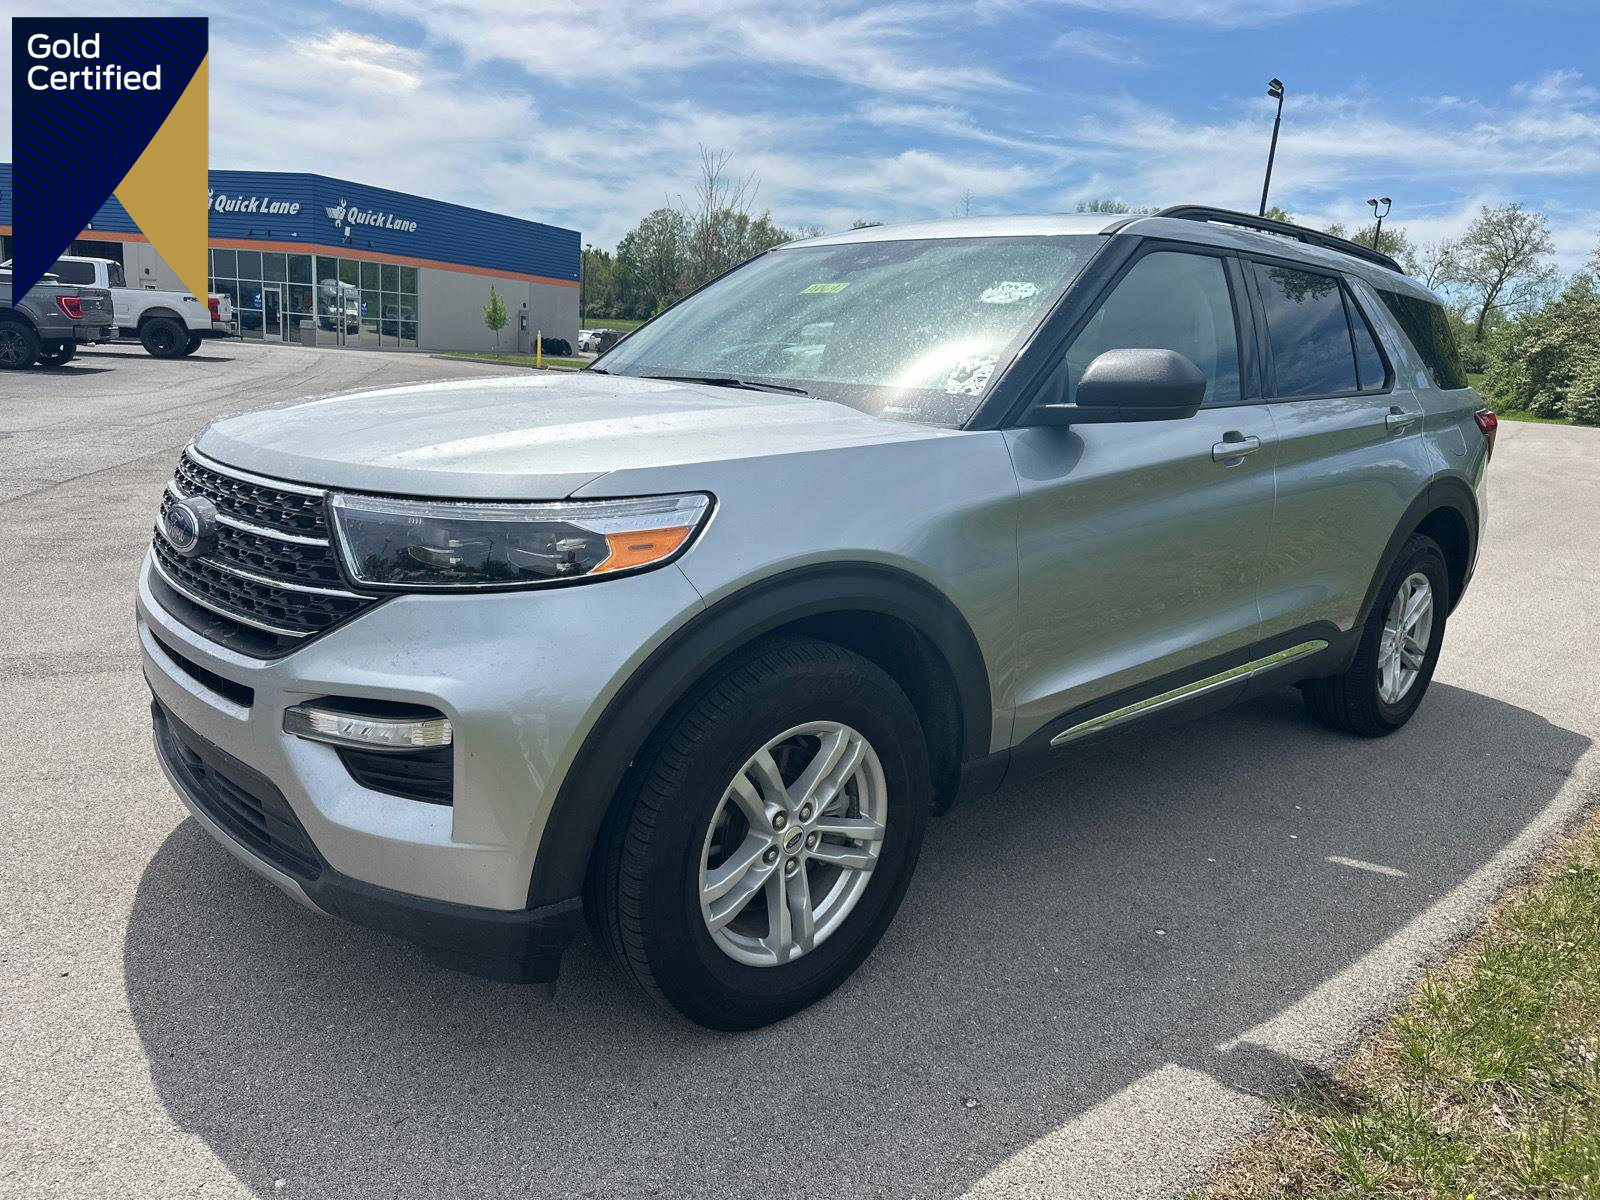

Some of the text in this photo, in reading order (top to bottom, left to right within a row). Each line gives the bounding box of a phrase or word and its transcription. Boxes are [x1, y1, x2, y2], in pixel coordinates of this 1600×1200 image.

[215, 195, 300, 215] Quick Lane
[347, 207, 417, 233] Quick Lane
